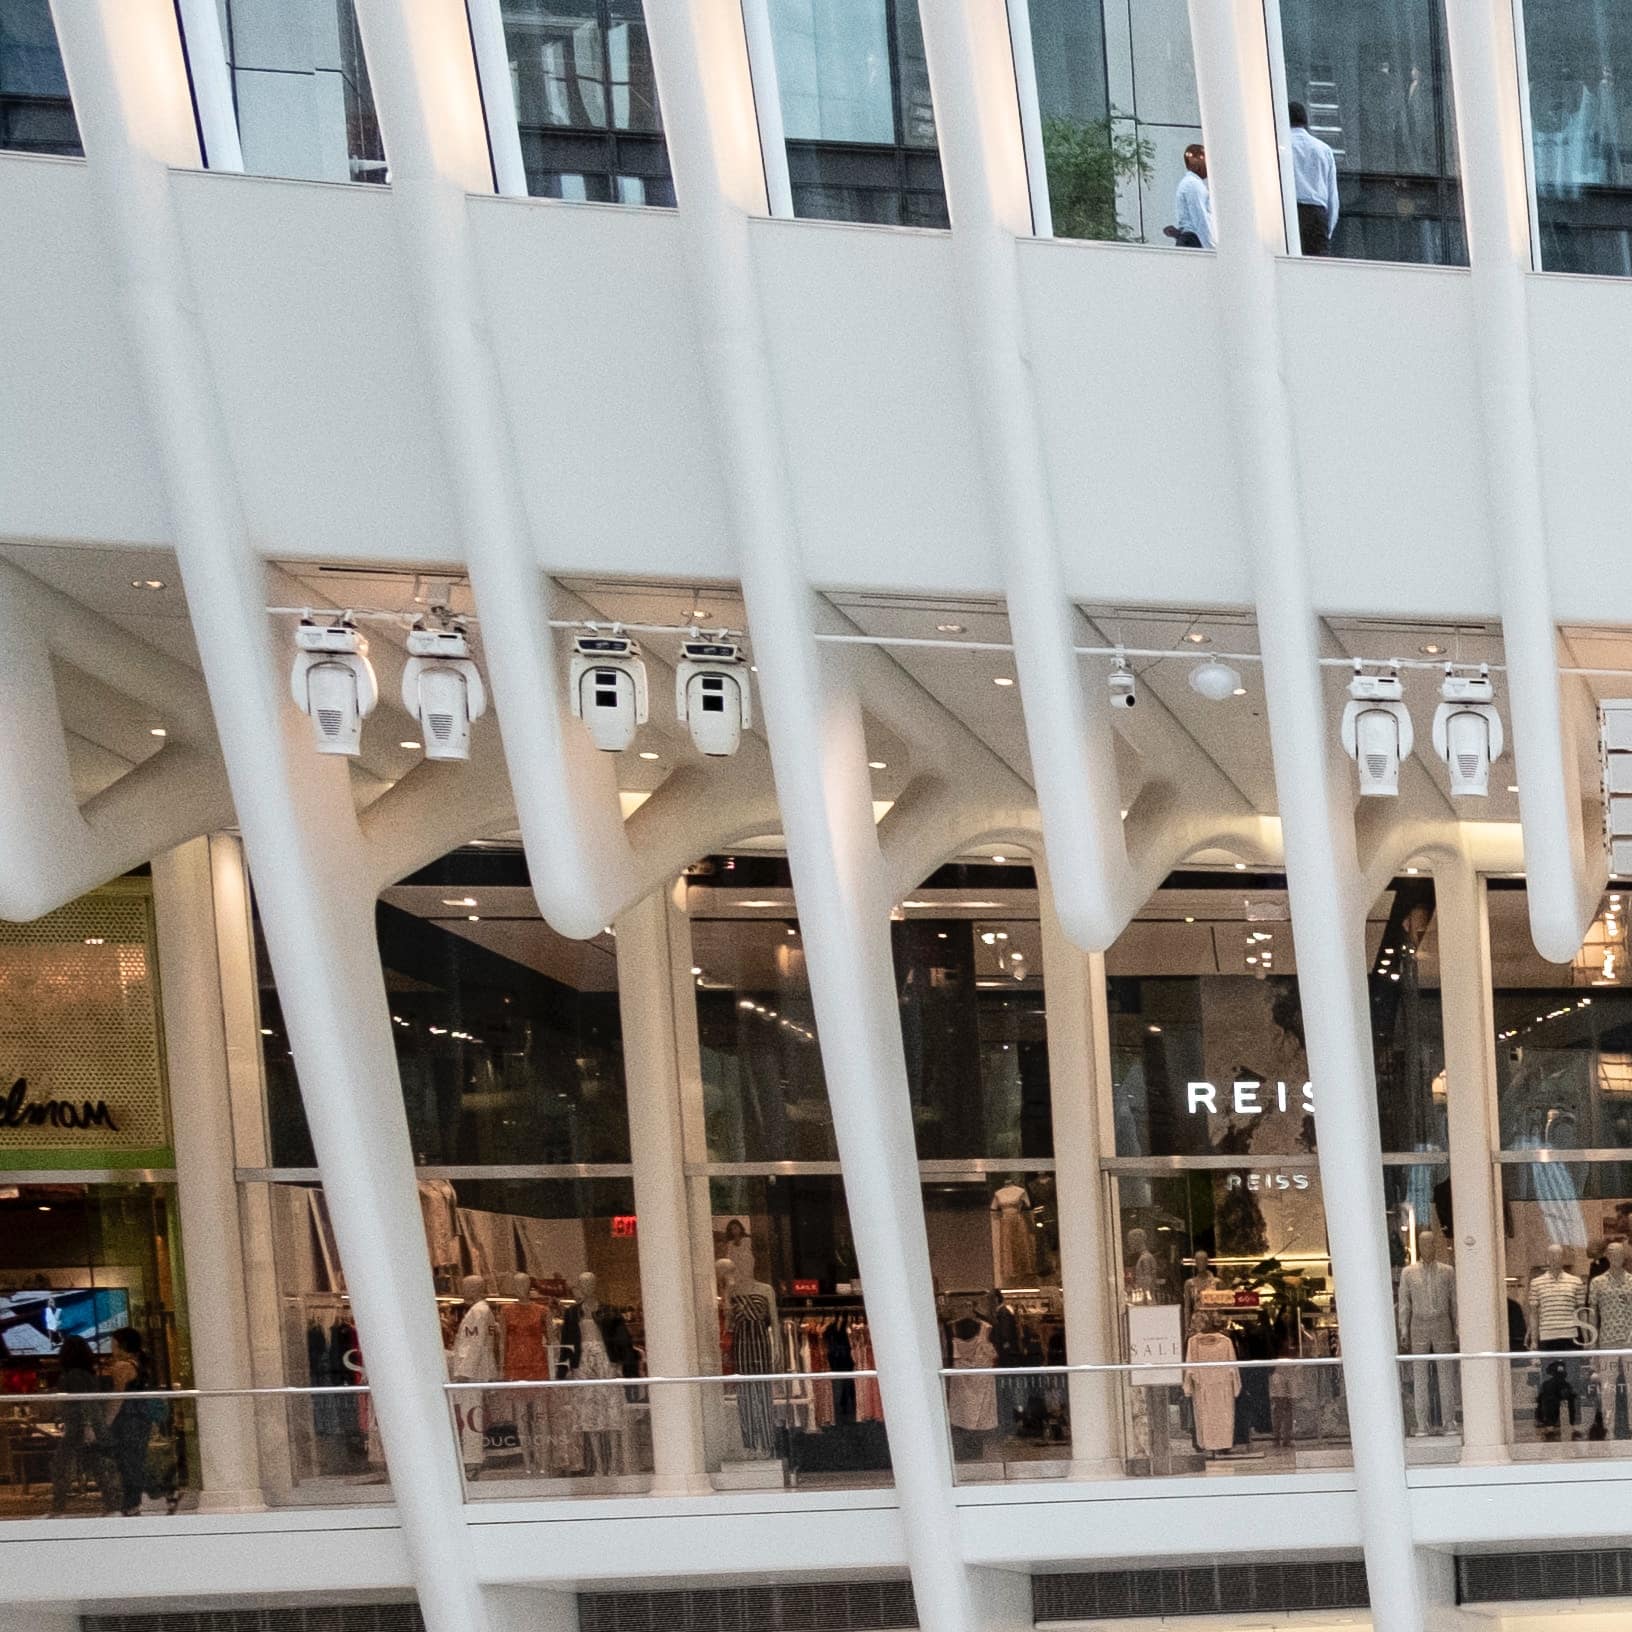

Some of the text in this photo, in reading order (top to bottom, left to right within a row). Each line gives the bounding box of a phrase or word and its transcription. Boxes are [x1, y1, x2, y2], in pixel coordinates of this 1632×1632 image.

[1187, 1081, 1316, 1115] REIS
[1226, 1173, 1309, 1191] REISS
[481, 1432, 572, 1449] DUCTIONS
